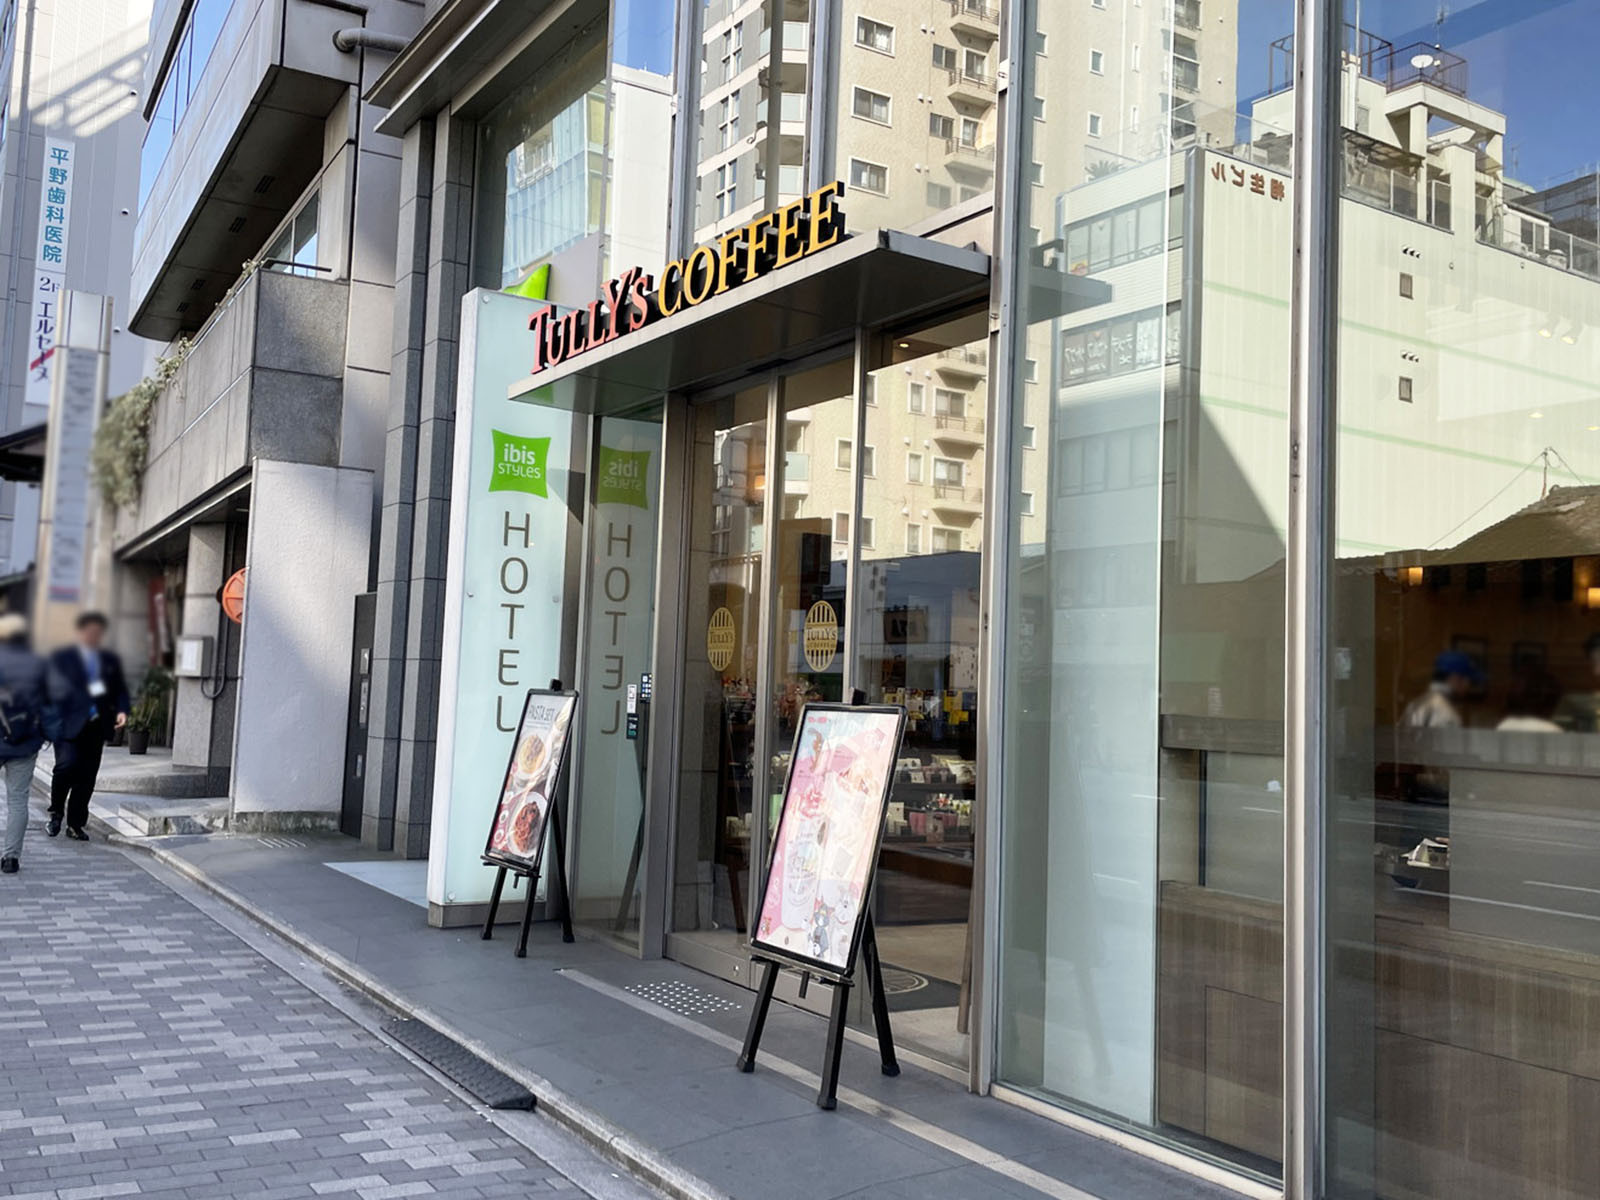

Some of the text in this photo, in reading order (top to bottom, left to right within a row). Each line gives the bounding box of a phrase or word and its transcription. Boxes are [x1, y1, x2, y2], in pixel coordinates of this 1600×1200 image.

[42, 147, 69, 263] 平野歯科医院
[528, 181, 845, 374] TULLY'S COFFEE
[503, 443, 536, 465] ibis
[496, 511, 531, 733] HOTEL
